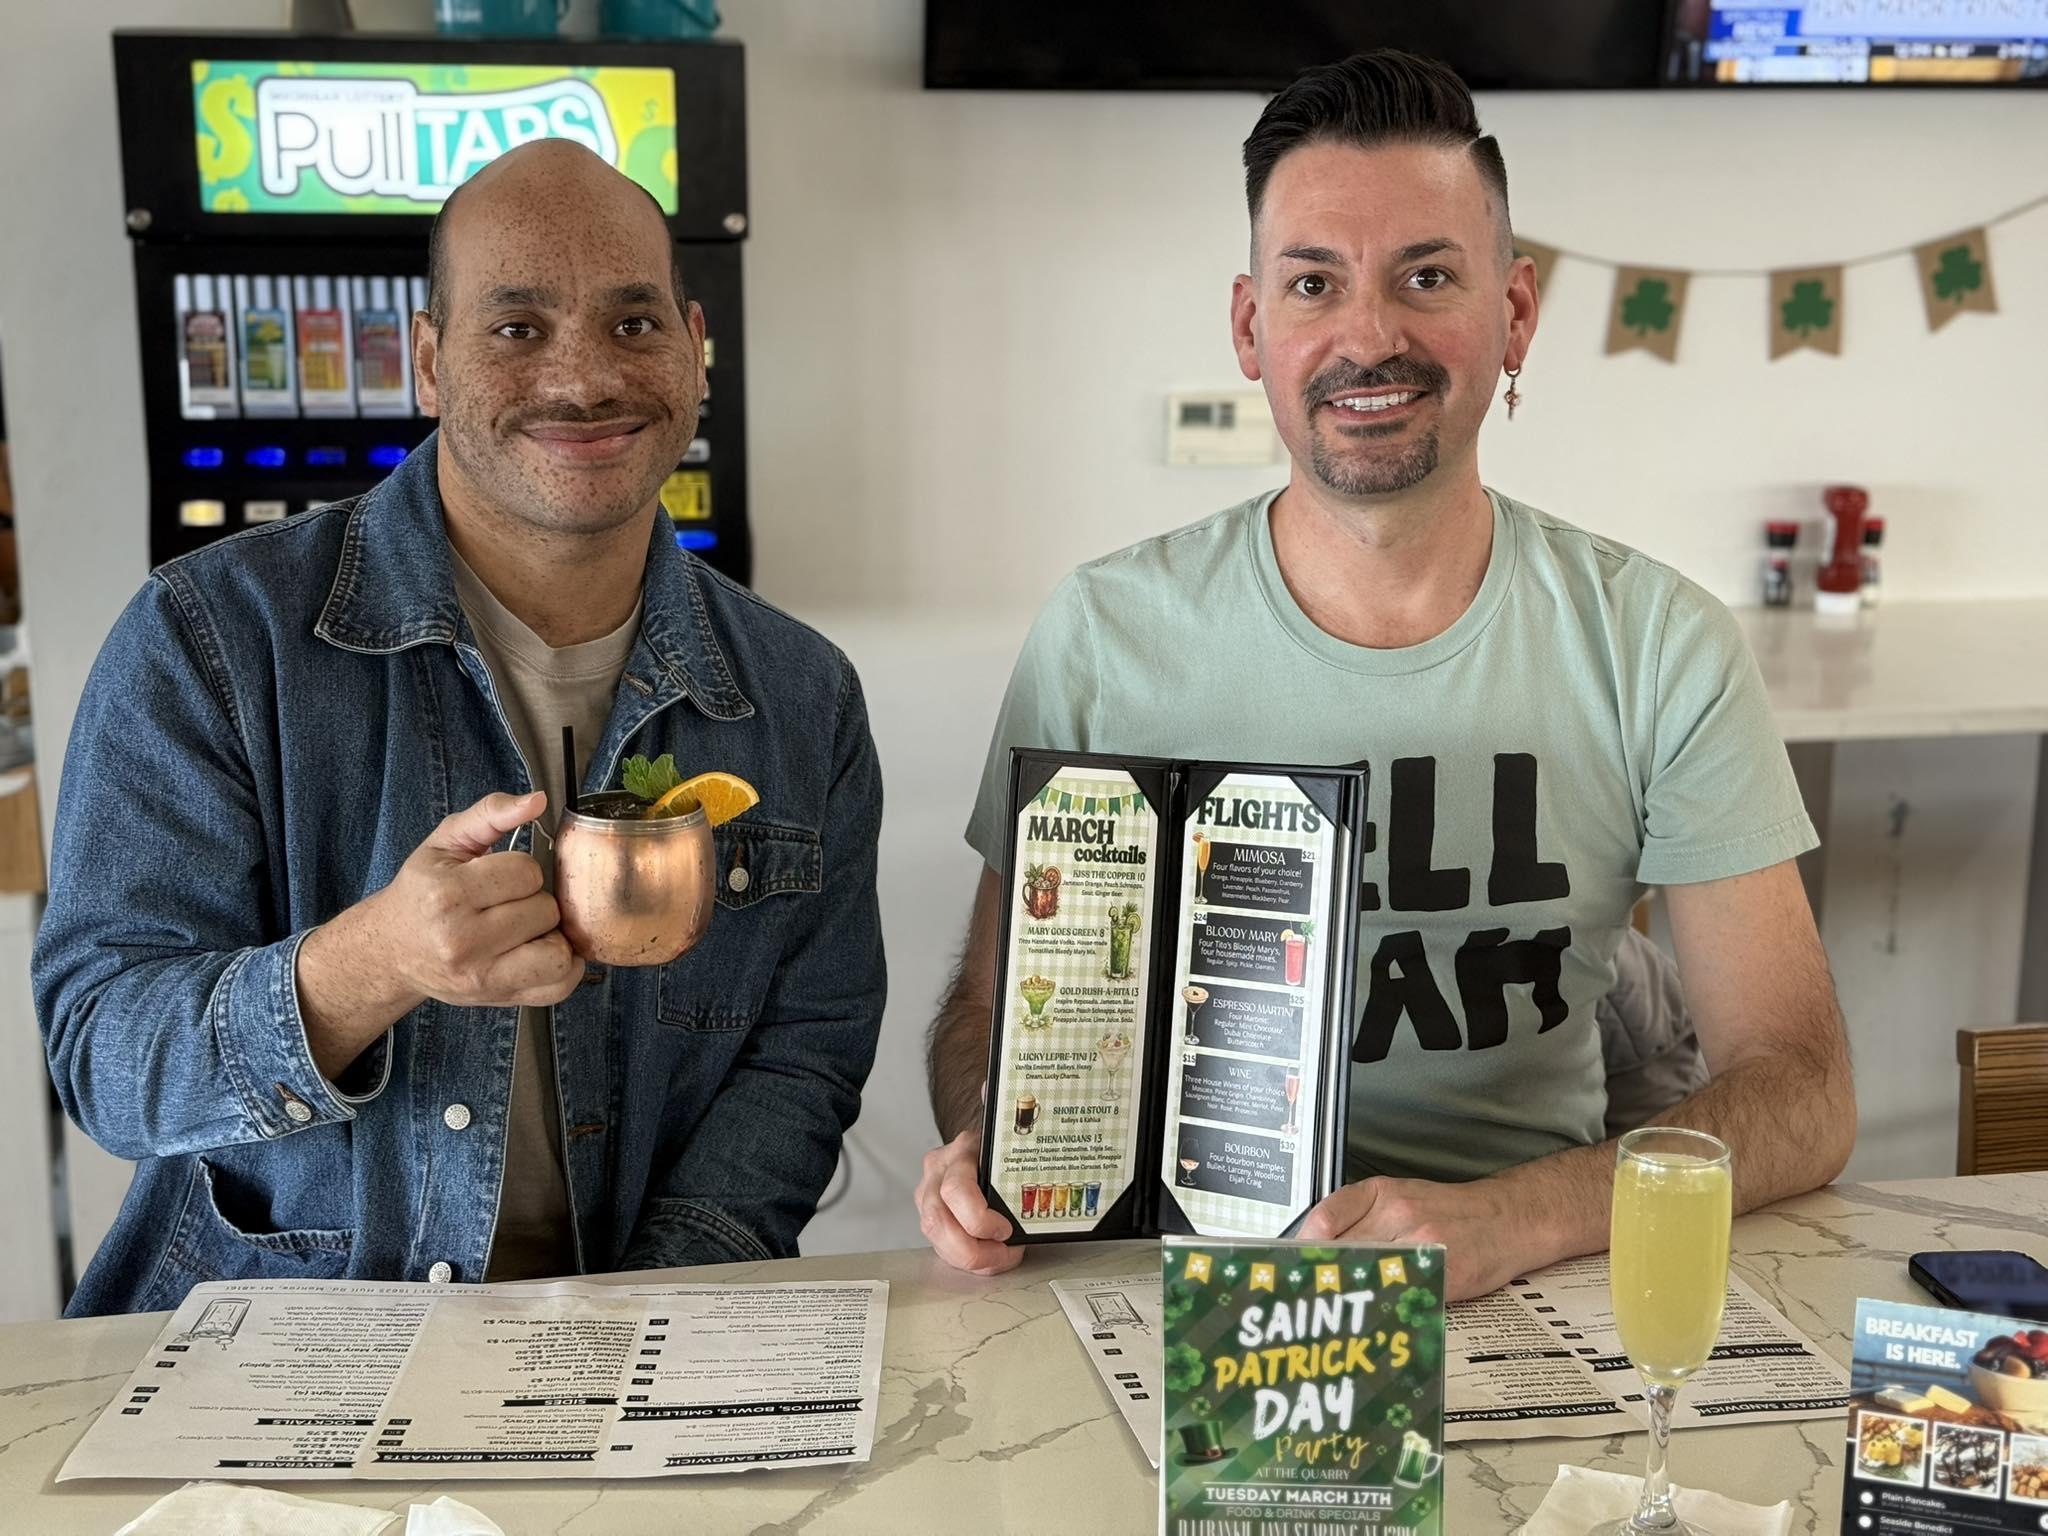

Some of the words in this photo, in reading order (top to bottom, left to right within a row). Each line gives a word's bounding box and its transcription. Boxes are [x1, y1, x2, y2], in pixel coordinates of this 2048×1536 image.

[272, 109, 405, 182] Pull
[1197, 797, 1321, 833] FLIGHTS
[1027, 815, 1115, 844] MARCH
[1073, 843, 1147, 864] cocktails
[1233, 848, 1286, 865] MIMOSA
[1072, 869, 1090, 879] KISS
[1091, 870, 1106, 880] THE
[1107, 871, 1136, 881] COPPER
[1137, 873, 1146, 882] 10
[1213, 862, 1228, 871] Four
[1229, 863, 1252, 873] flavors
[1253, 865, 1261, 873] of
[1260, 867, 1276, 876] your
[1277, 868, 1302, 877] choice!
[1027, 926, 1050, 936] MARY
[1051, 927, 1071, 936] GOES
[1072, 928, 1098, 937] GREEN
[1099, 928, 1105, 938] 8
[1206, 925, 1248, 940] BLOODY
[1248, 929, 1279, 943] MARY
[1198, 938, 1213, 947] Four
[1215, 940, 1232, 950] Tito's
[1233, 942, 1256, 954] Bloody
[1200, 946, 1214, 955] four
[1216, 948, 1255, 960] housemade
[1060, 987, 1082, 996] GOLD
[1082, 987, 1130, 997] RUSH-A-RITA
[1131, 987, 1139, 997] 13
[1213, 998, 1257, 1013] ESPRESSO
[1256, 1003, 1294, 1018] MARTINI
[1018, 1052, 1045, 1061] LUCKY
[1045, 1052, 1087, 1062] LEPRE-TINI
[1228, 1066, 1252, 1079] WINE
[1184, 1074, 1202, 1084] Three
[1203, 1077, 1223, 1088] House
[1242, 1083, 1250, 1091] of
[1052, 1106, 1079, 1115] SHORT
[1079, 1106, 1086, 1115] &
[1085, 1105, 1112, 1114] STOUT
[1113, 1106, 1120, 1115] 8
[1036, 1134, 1092, 1144] SHENANIGANS
[1093, 1134, 1103, 1143] 13
[1224, 1142, 1271, 1159] BOURBON
[1209, 1152, 1224, 1162] Four
[1225, 1155, 1255, 1168] bourbon
[1237, 1289, 1375, 1347] SAINT
[1865, 1316, 1980, 1349] BREAKFAST
[1213, 1331, 1411, 1392] PATRICK'S
[1885, 1343, 1904, 1360] IS
[1907, 1345, 1962, 1369] HERE.
[543, 1398, 587, 1406] SIDES
[717, 1405, 775, 1414] BOWLS,
[779, 1402, 856, 1411] BURRITOS,
[1252, 1376, 1355, 1441] DAY
[1519, 1404, 1616, 1415] TRADITIONAL
[1699, 1402, 1779, 1414] SANDWICH
[627, 1409, 713, 1418] OMELETTES
[758, 1449, 849, 1460] BREAKFAST
[1275, 1431, 1370, 1470] Party
[669, 1455, 756, 1465] SANDWICH
[1255, 1467, 1271, 1480] AT
[1273, 1468, 1299, 1480] THE
[1300, 1468, 1351, 1481] QUARRY
[1205, 1486, 1282, 1502] TUESDAY
[1285, 1489, 1348, 1504] MARCH
[1352, 1490, 1392, 1506] 17TH
[1881, 1491, 1903, 1502] Plain
[1904, 1495, 1947, 1509] Pancakes
[1226, 1506, 1263, 1518] FOOD
[1264, 1507, 1274, 1519] &
[1276, 1508, 1317, 1520] DRINK
[1318, 1509, 1381, 1522] SPECIALS
[1879, 1516, 1913, 1528] Seaside
[1914, 1520, 1954, 1534] Benedict
